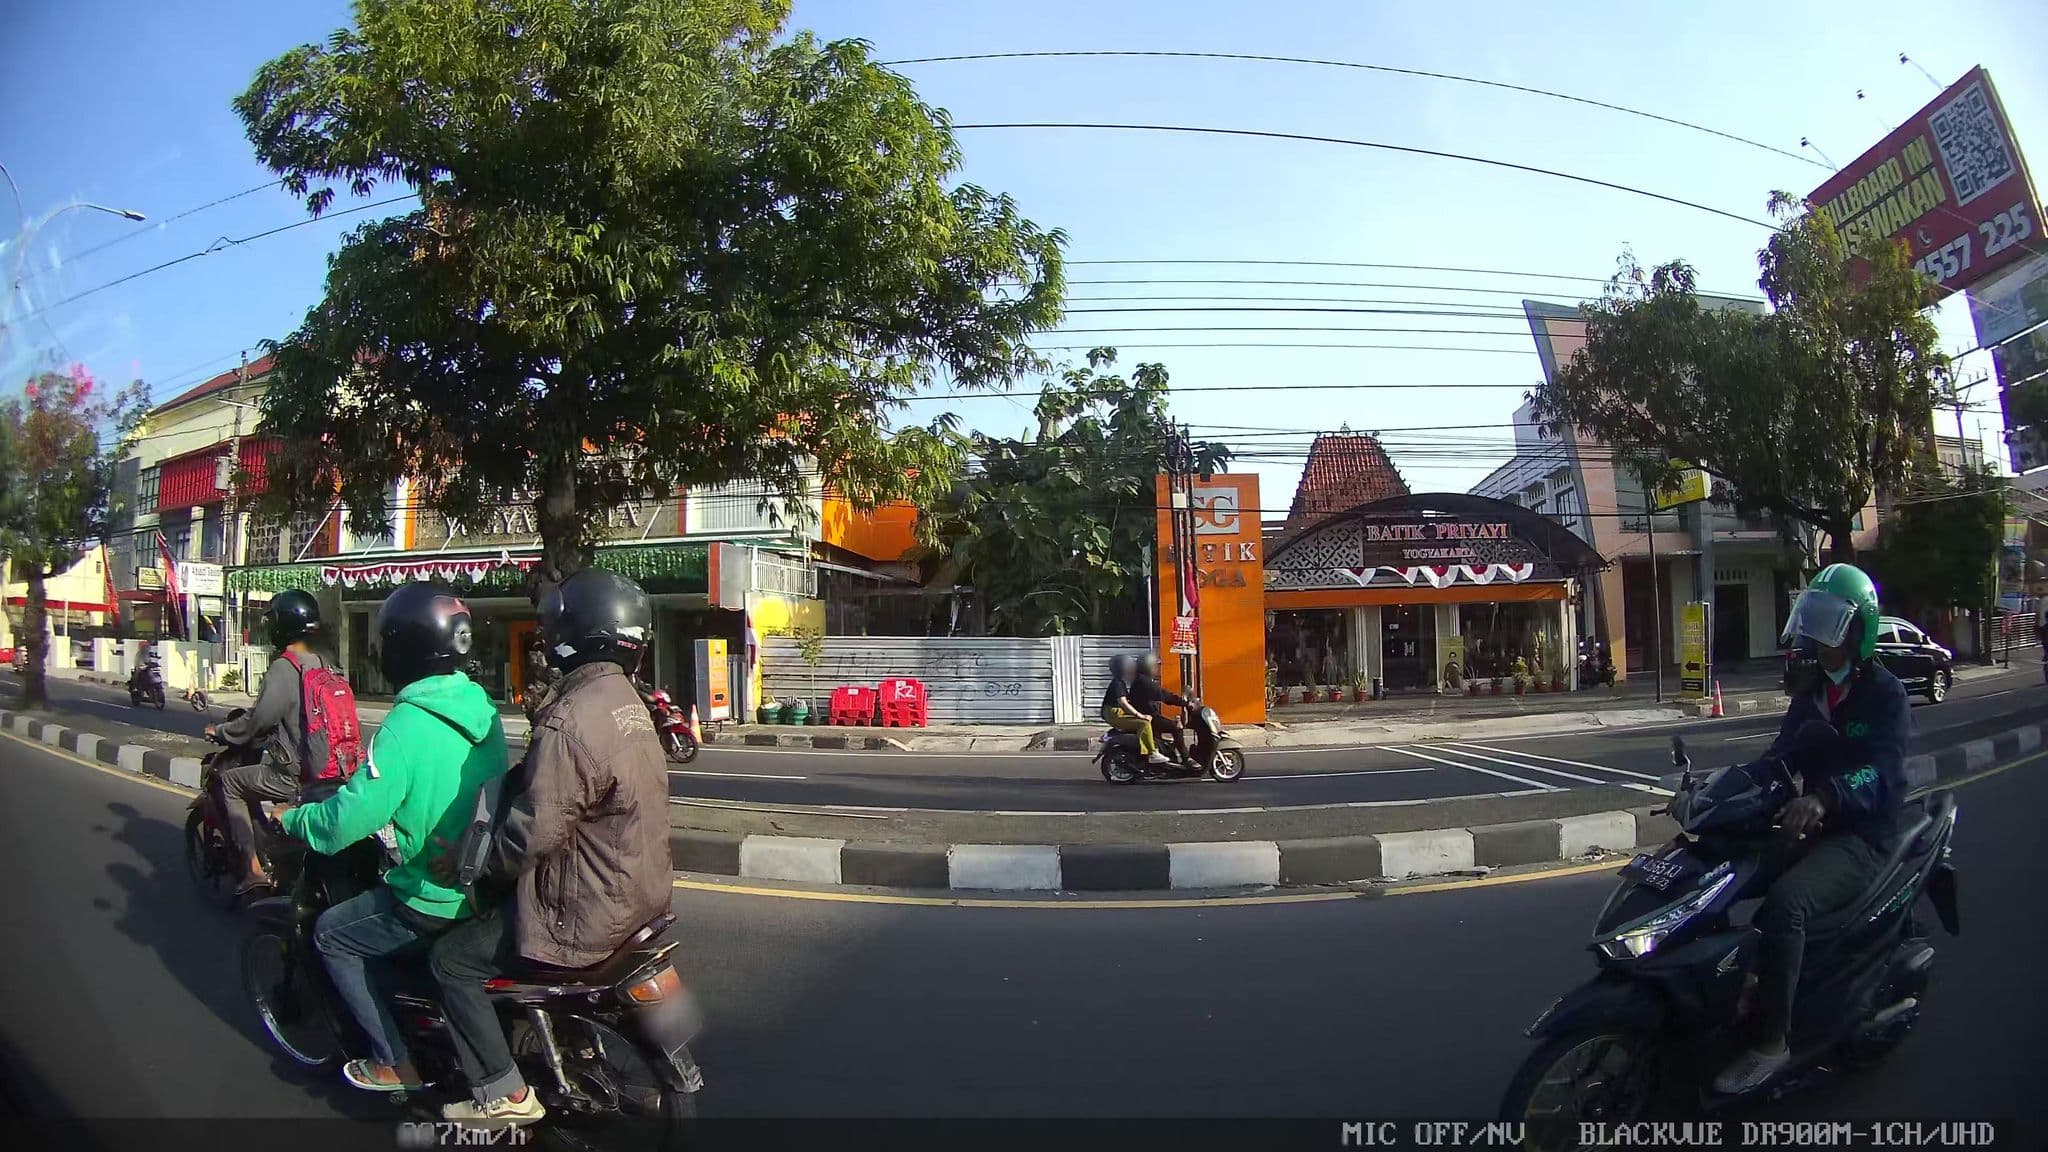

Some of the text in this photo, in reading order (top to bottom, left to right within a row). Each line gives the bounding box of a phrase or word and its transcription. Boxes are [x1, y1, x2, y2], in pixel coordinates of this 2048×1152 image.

[1902, 134, 1933, 175] INI
[1978, 201, 2032, 258] 225
[1366, 523, 1508, 541] BATIK PRIYAYI
[1402, 547, 1478, 559] YOGYAKARTA
